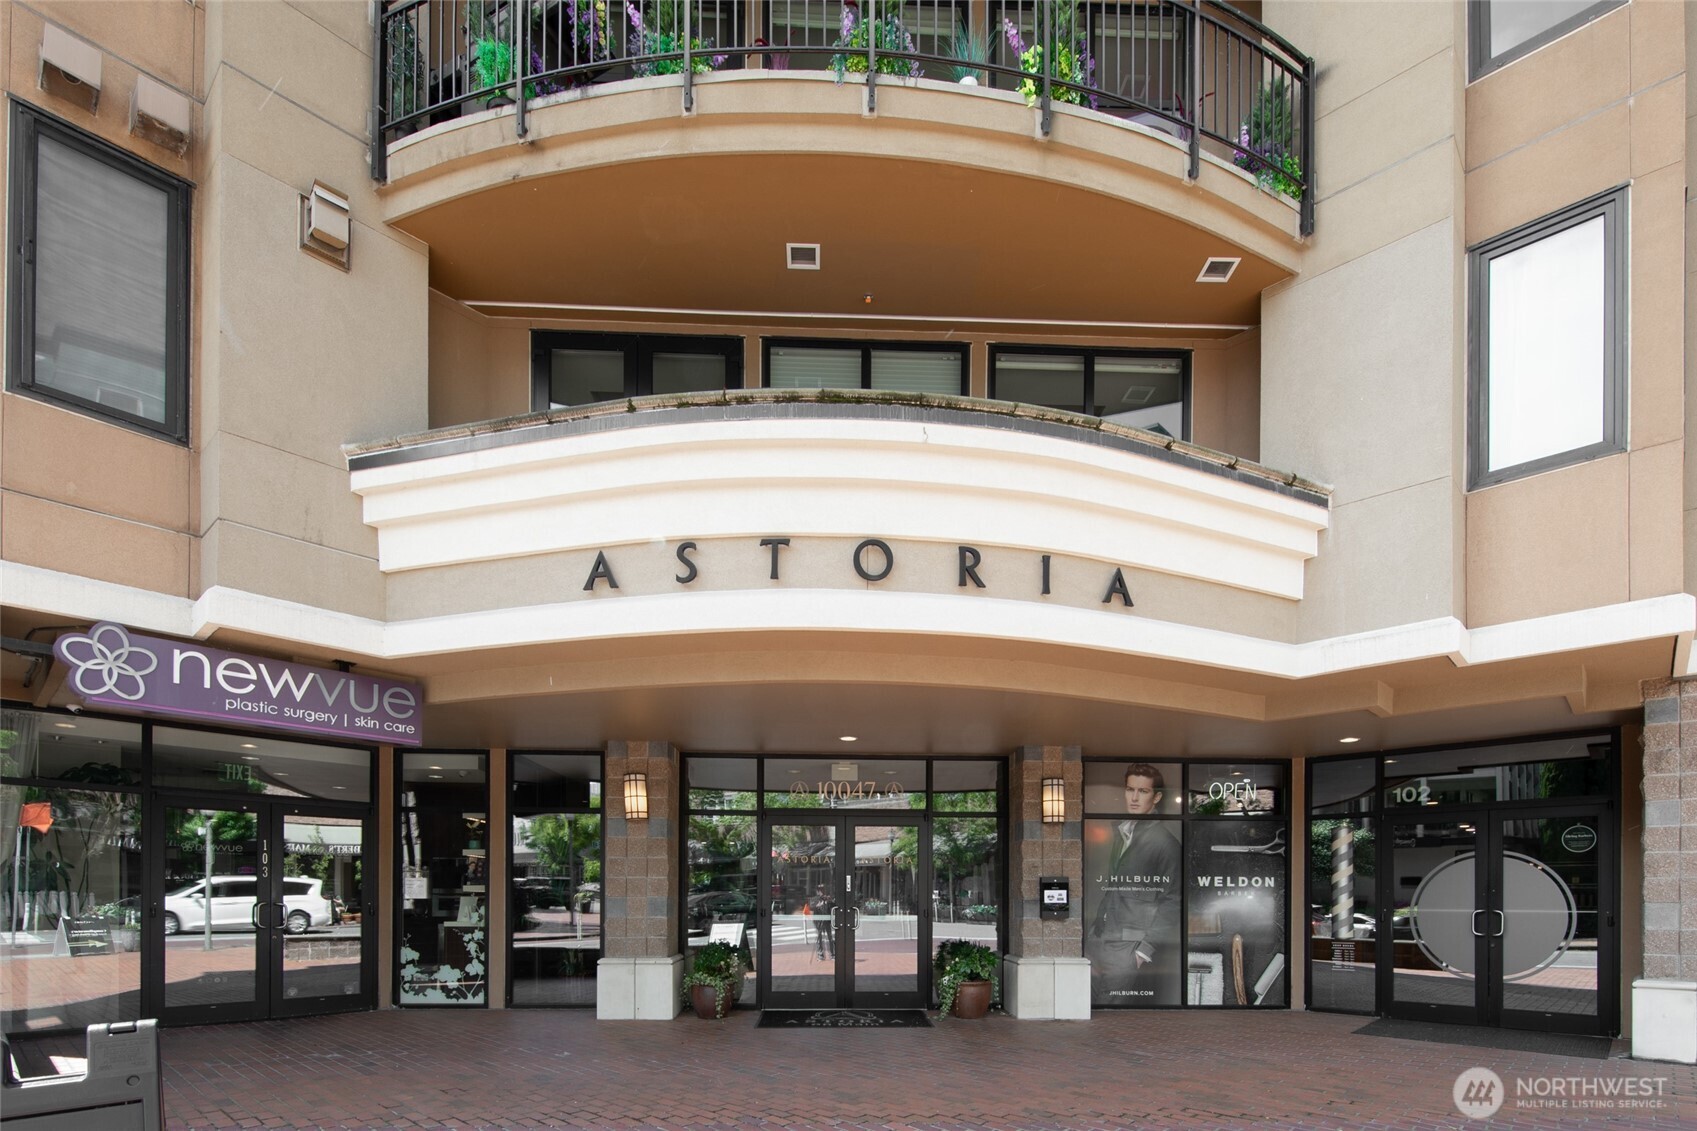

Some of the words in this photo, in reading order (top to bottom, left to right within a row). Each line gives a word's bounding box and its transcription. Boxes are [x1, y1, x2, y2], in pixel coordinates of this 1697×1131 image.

[582, 538, 1135, 607] ASTORIA
[173, 649, 416, 718] newvue
[225, 698, 278, 715] plastic
[284, 705, 338, 725] surgery
[354, 716, 379, 729] skin
[384, 721, 416, 734] care
[816, 781, 876, 800] 10047
[1209, 782, 1257, 801] OPEN
[1392, 786, 1431, 803] 102
[1096, 875, 1170, 883] J.HILBURN
[1197, 876, 1275, 888] WELDON
